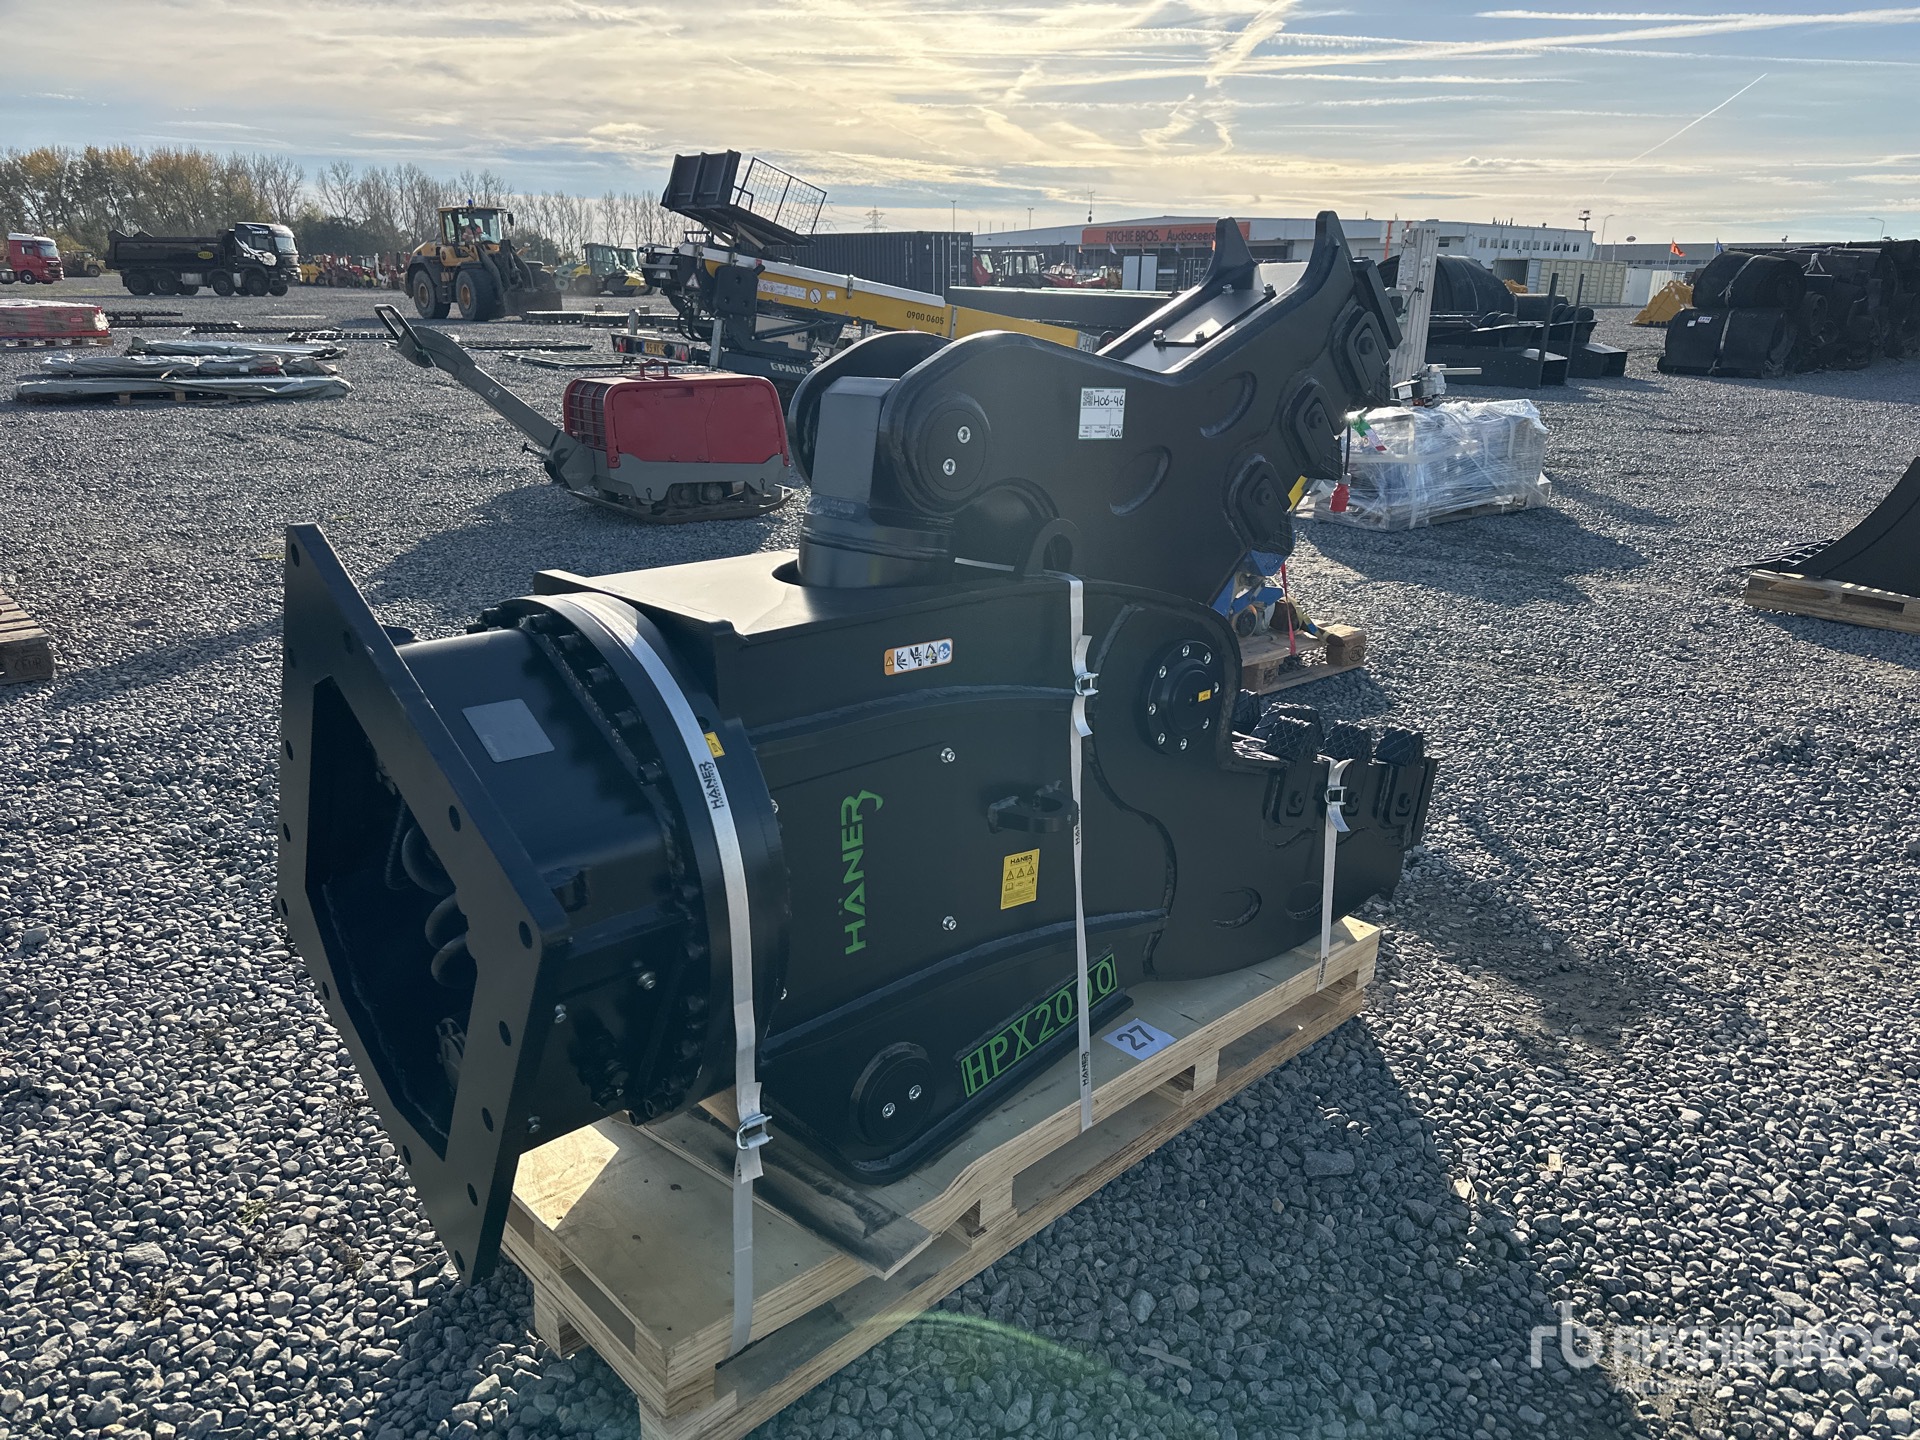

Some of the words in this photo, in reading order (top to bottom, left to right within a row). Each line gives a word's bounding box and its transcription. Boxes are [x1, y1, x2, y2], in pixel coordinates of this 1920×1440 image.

[1105, 230, 1134, 243] RITCHIE
[1135, 229, 1162, 242] BROS.
[1166, 229, 1216, 241] Auctioneers
[906, 310, 925, 322] 0900
[926, 312, 945, 325] 0605
[1093, 394, 1124, 407] H06-46
[698, 761, 722, 810] HÄNER
[837, 789, 884, 955] HÄNER
[1116, 1024, 1155, 1051] 27
